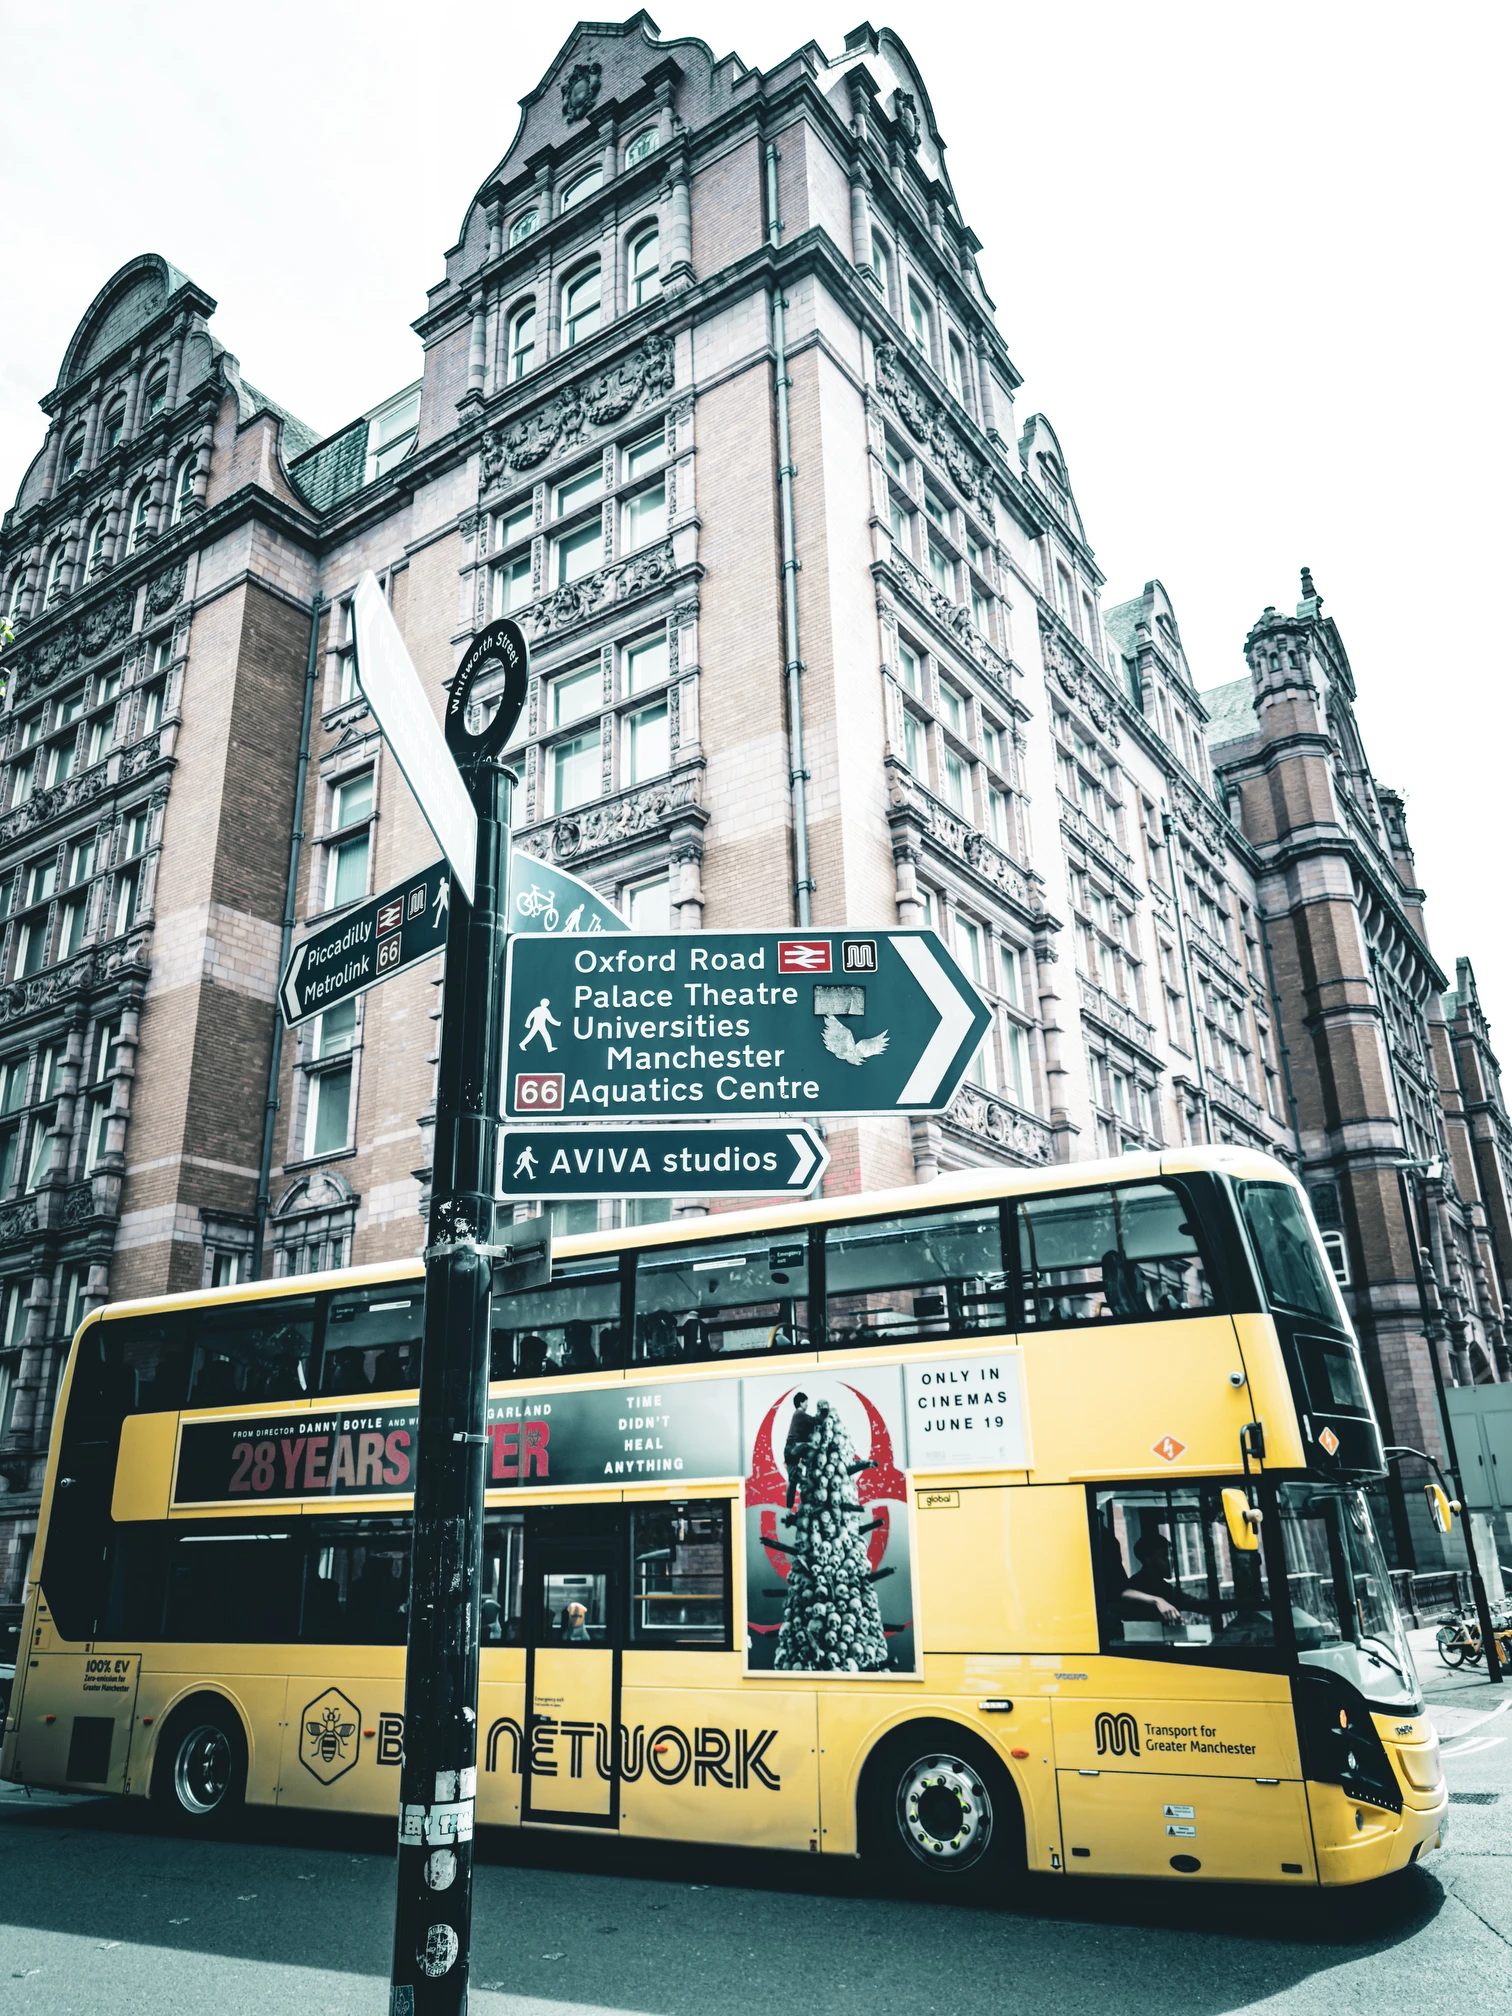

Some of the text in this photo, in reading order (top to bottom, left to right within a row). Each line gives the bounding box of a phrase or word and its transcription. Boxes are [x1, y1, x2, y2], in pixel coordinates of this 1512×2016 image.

[451, 631, 520, 715] Whitworth Street
[586, 913, 607, 932] Th
[307, 921, 373, 971] Piccadilly
[575, 947, 765, 973] Oxford Road
[304, 940, 398, 1005] Metrolink 66
[575, 983, 798, 1009] Palace Theatre
[573, 1014, 750, 1040] Universities
[607, 1045, 785, 1071] Manchester
[521, 1076, 820, 1108] 66 Aquatics Centre
[550, 1147, 778, 1174] AVIVA studios
[921, 1368, 1000, 1385] ONLY IN
[626, 1395, 662, 1409] TIME
[918, 1391, 1007, 1409] CINEMAS
[233, 1430, 254, 1438] FROM
[256, 1427, 295, 1437] DIRECTOR
[299, 1421, 338, 1434] DANNY
[343, 1417, 382, 1431] BOYLE
[388, 1418, 405, 1427] AND
[488, 1403, 552, 1419] GARLAND
[618, 1415, 670, 1430] DIDN'T
[924, 1416, 1004, 1432] JUNE 19
[624, 1437, 664, 1451] HEAL
[228, 1440, 276, 1492] 28
[280, 1430, 411, 1490] YEARS
[604, 1458, 684, 1474] ANYTHING
[926, 1494, 951, 1506] global
[86, 1659, 130, 1673] 100% EV
[84, 1674, 118, 1682] Zero-emission
[83, 1683, 129, 1693] Greater Manchester
[1144, 1723, 1217, 1739] Transport for
[486, 1717, 781, 1792] NETWORK
[1146, 1739, 1256, 1755] Greater Manchester
